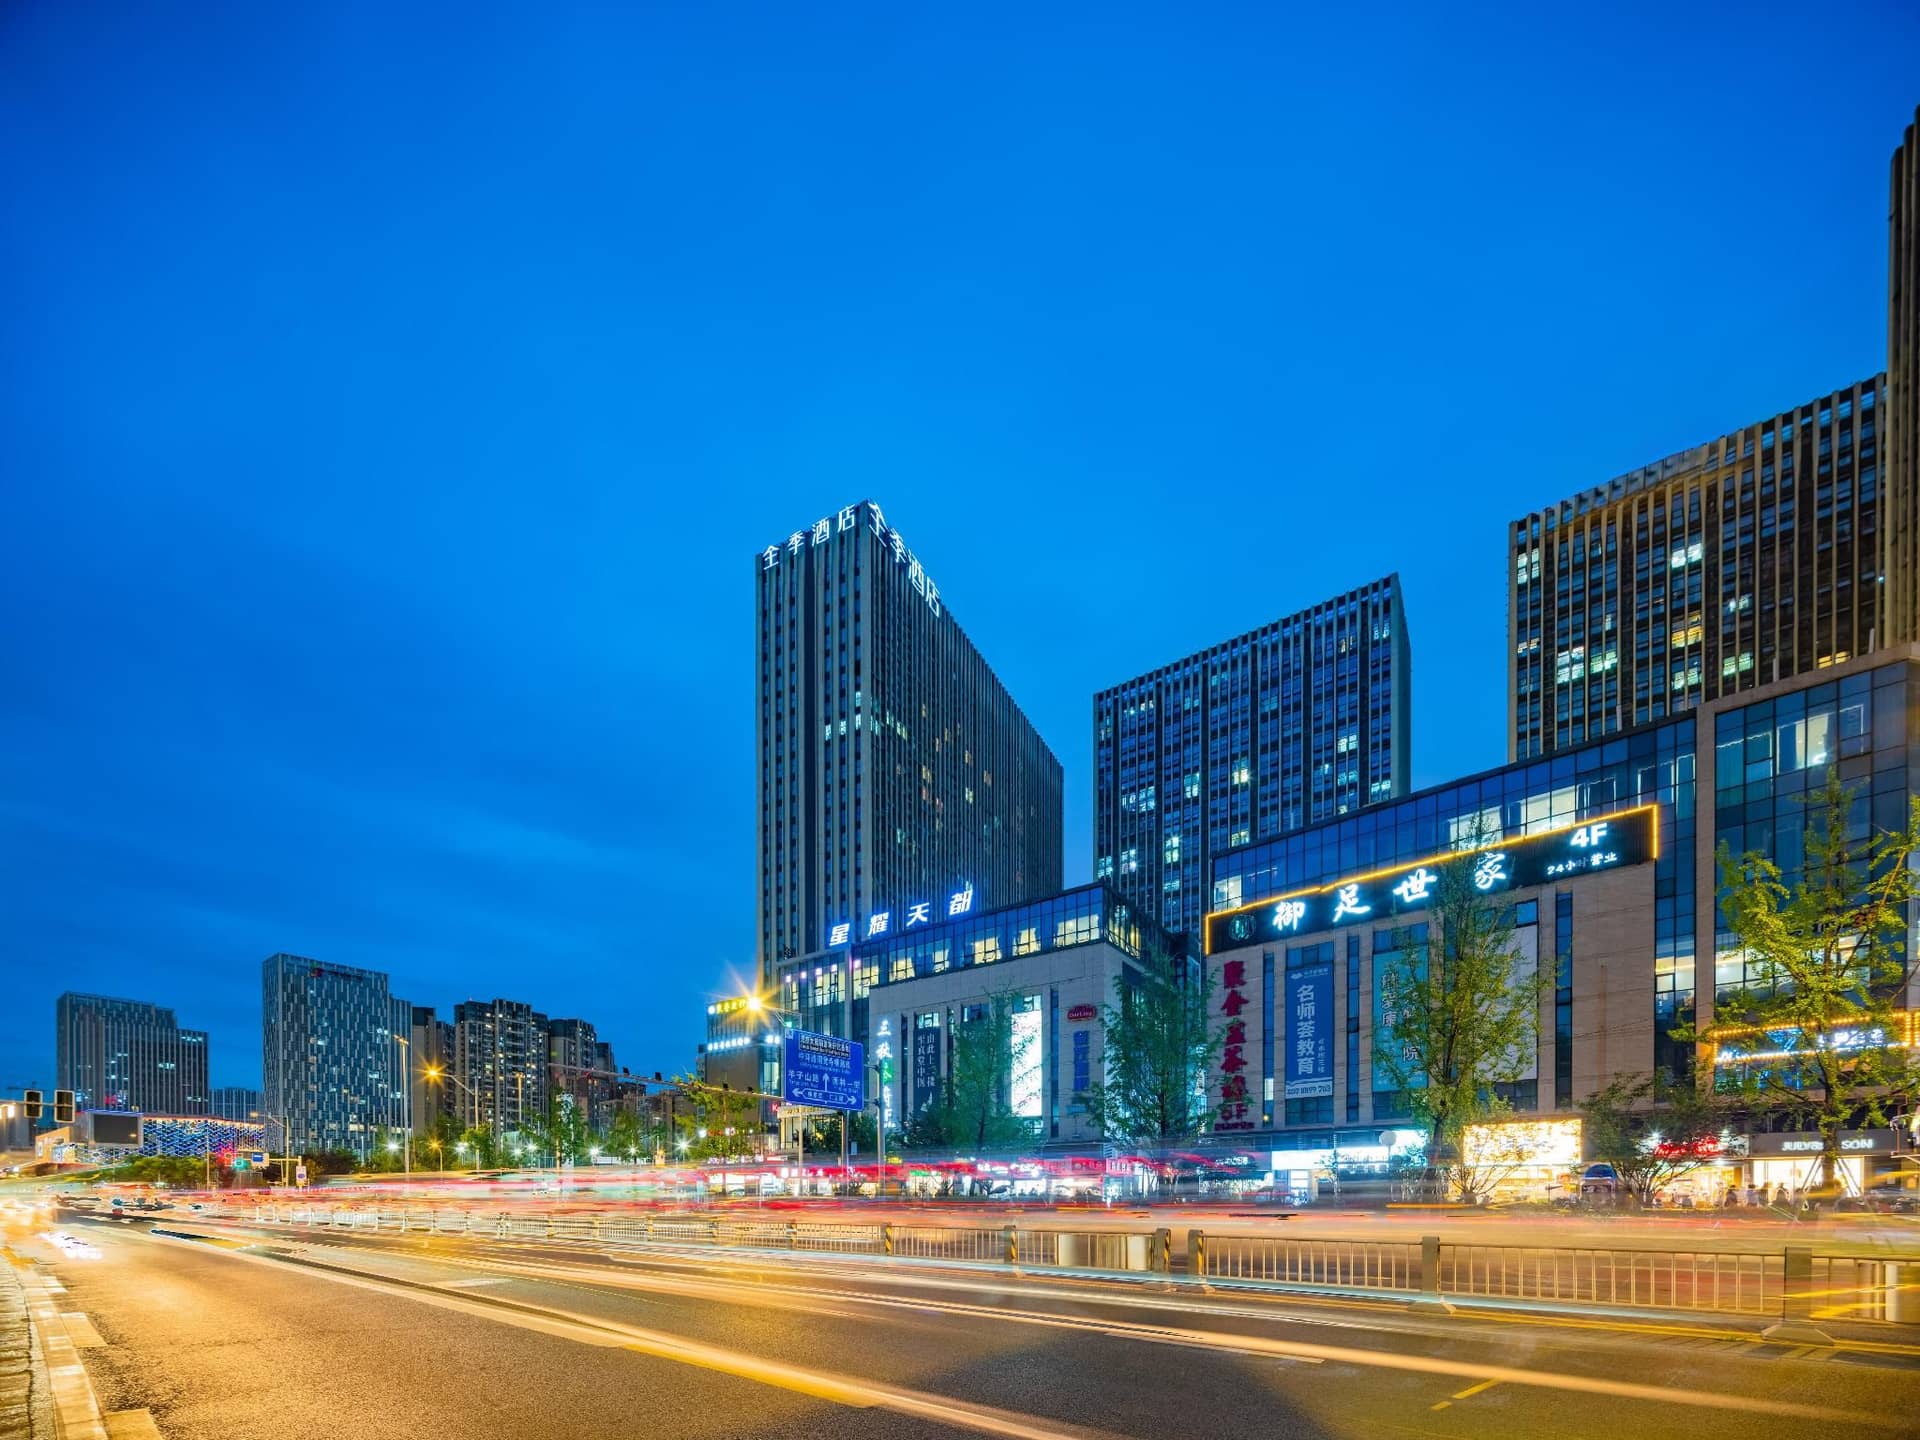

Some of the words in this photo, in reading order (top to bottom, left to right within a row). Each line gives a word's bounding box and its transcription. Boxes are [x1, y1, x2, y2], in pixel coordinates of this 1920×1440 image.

[762, 503, 856, 570] 全季酒店
[868, 502, 941, 618] 全季酒店
[1546, 852, 1618, 876] 24小时营业
[1570, 822, 1608, 848] 4F
[829, 888, 973, 947] 星耀天都
[1273, 853, 1507, 931] 御足世家
[1296, 984, 1316, 1075] 名师荟教育
[788, 1070, 819, 1083] 羊子山路
